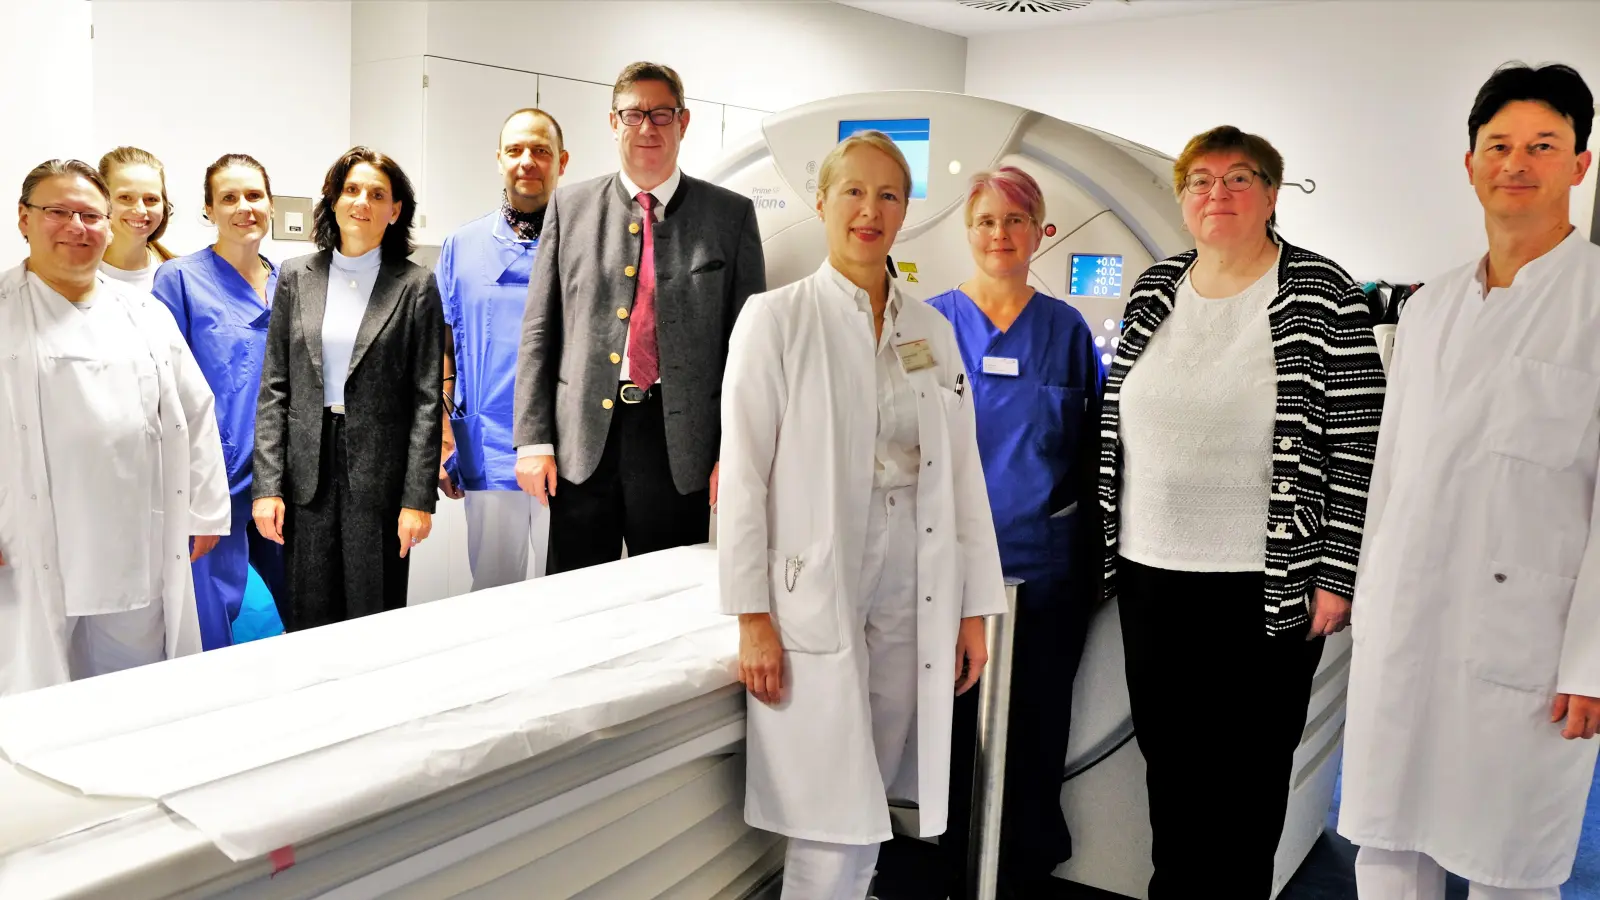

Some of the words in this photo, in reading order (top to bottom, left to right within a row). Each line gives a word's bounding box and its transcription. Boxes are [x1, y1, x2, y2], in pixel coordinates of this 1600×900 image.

[1096, 257, 1116, 266] +0.0
[1096, 267, 1115, 276] +0.0
[1095, 276, 1115, 286] +0.0
[1093, 285, 1108, 295] 0.0
